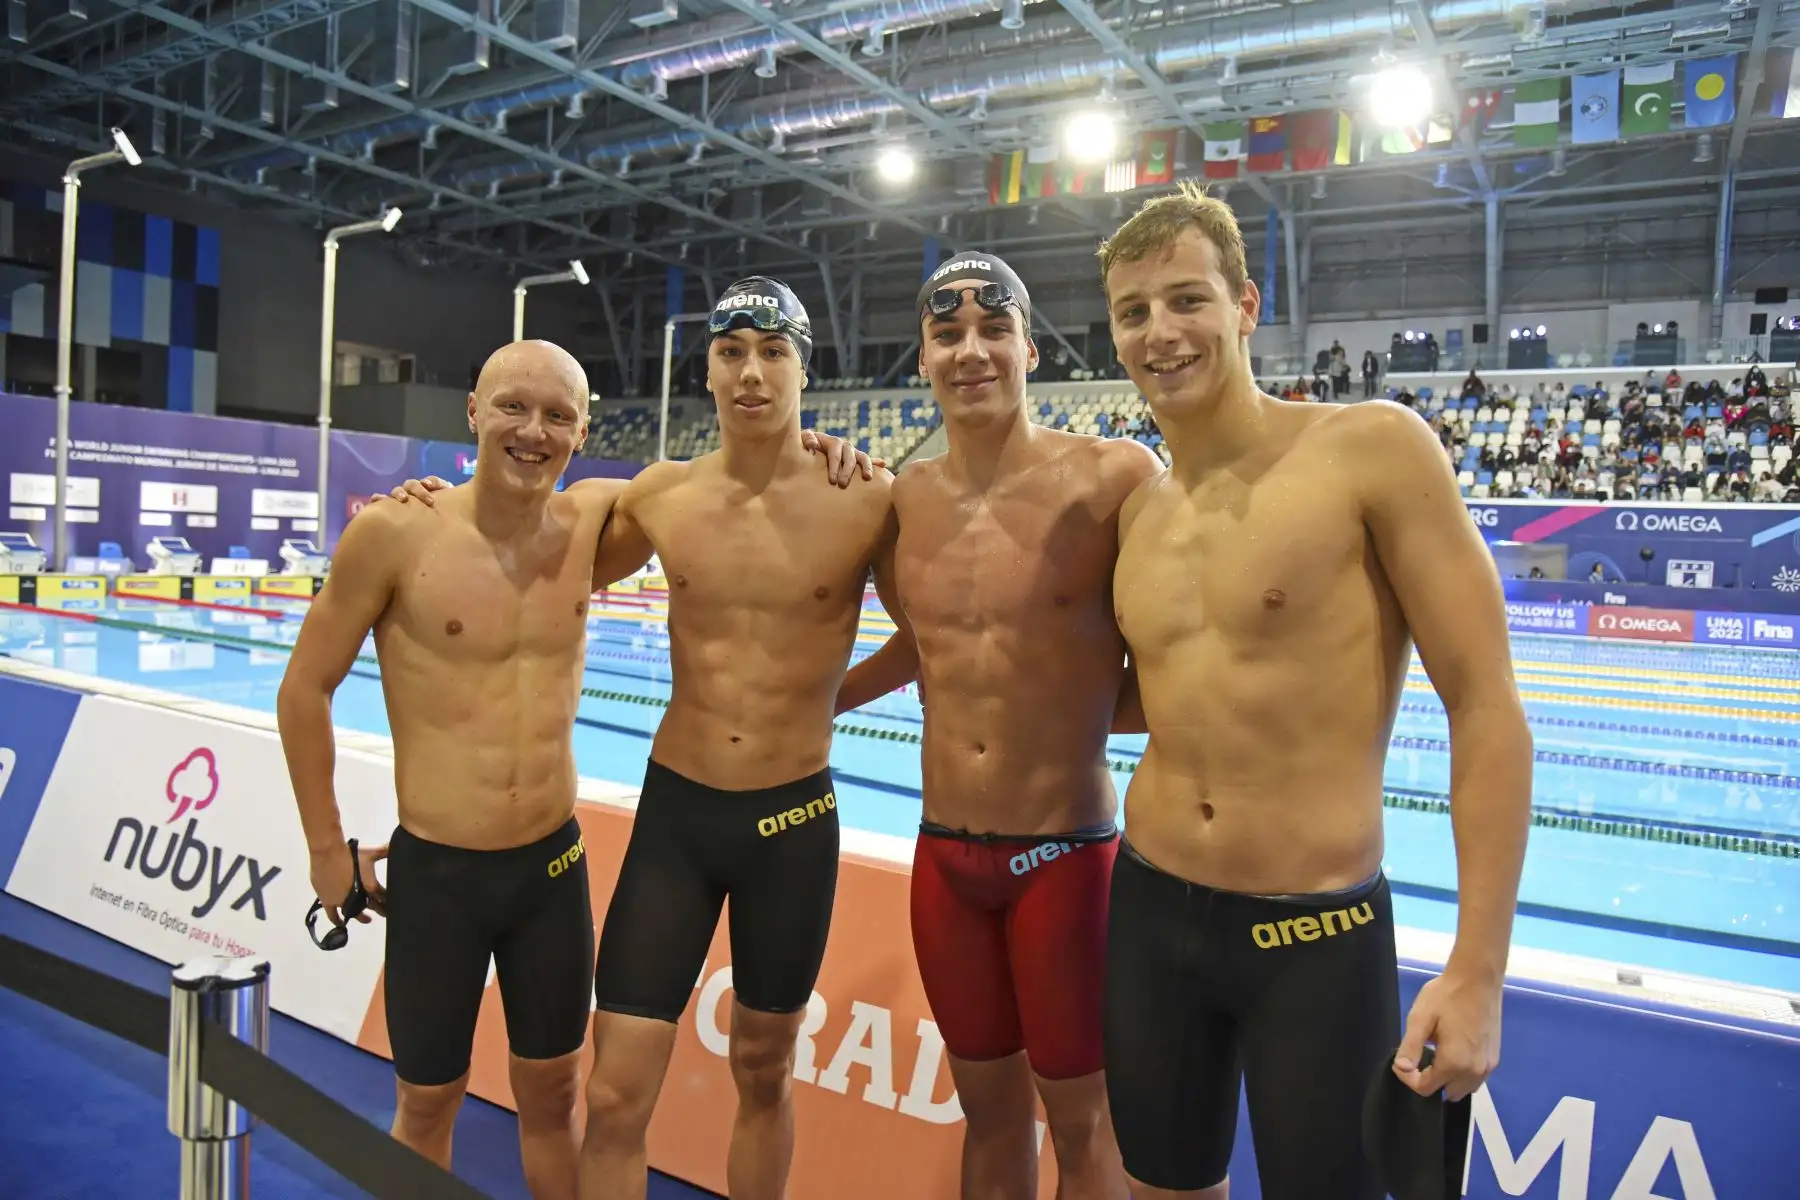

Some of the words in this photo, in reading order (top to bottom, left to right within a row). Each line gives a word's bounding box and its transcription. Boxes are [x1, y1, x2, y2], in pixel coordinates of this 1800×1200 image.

[933, 260, 991, 280] arena
[716, 294, 779, 310] arena
[49, 437, 74, 448] FA
[1642, 514, 1722, 532] OMEGA
[1557, 607, 1575, 619] US
[1620, 616, 1682, 633] OMEGA
[1706, 616, 1744, 629] LIMA
[1708, 628, 1743, 640] 2022
[758, 792, 836, 837] arena
[104, 817, 282, 920] nubyx
[123, 899, 135, 912] en
[135, 901, 158, 921] Fibra
[188, 925, 211, 944] para
[212, 933, 224, 948] tu
